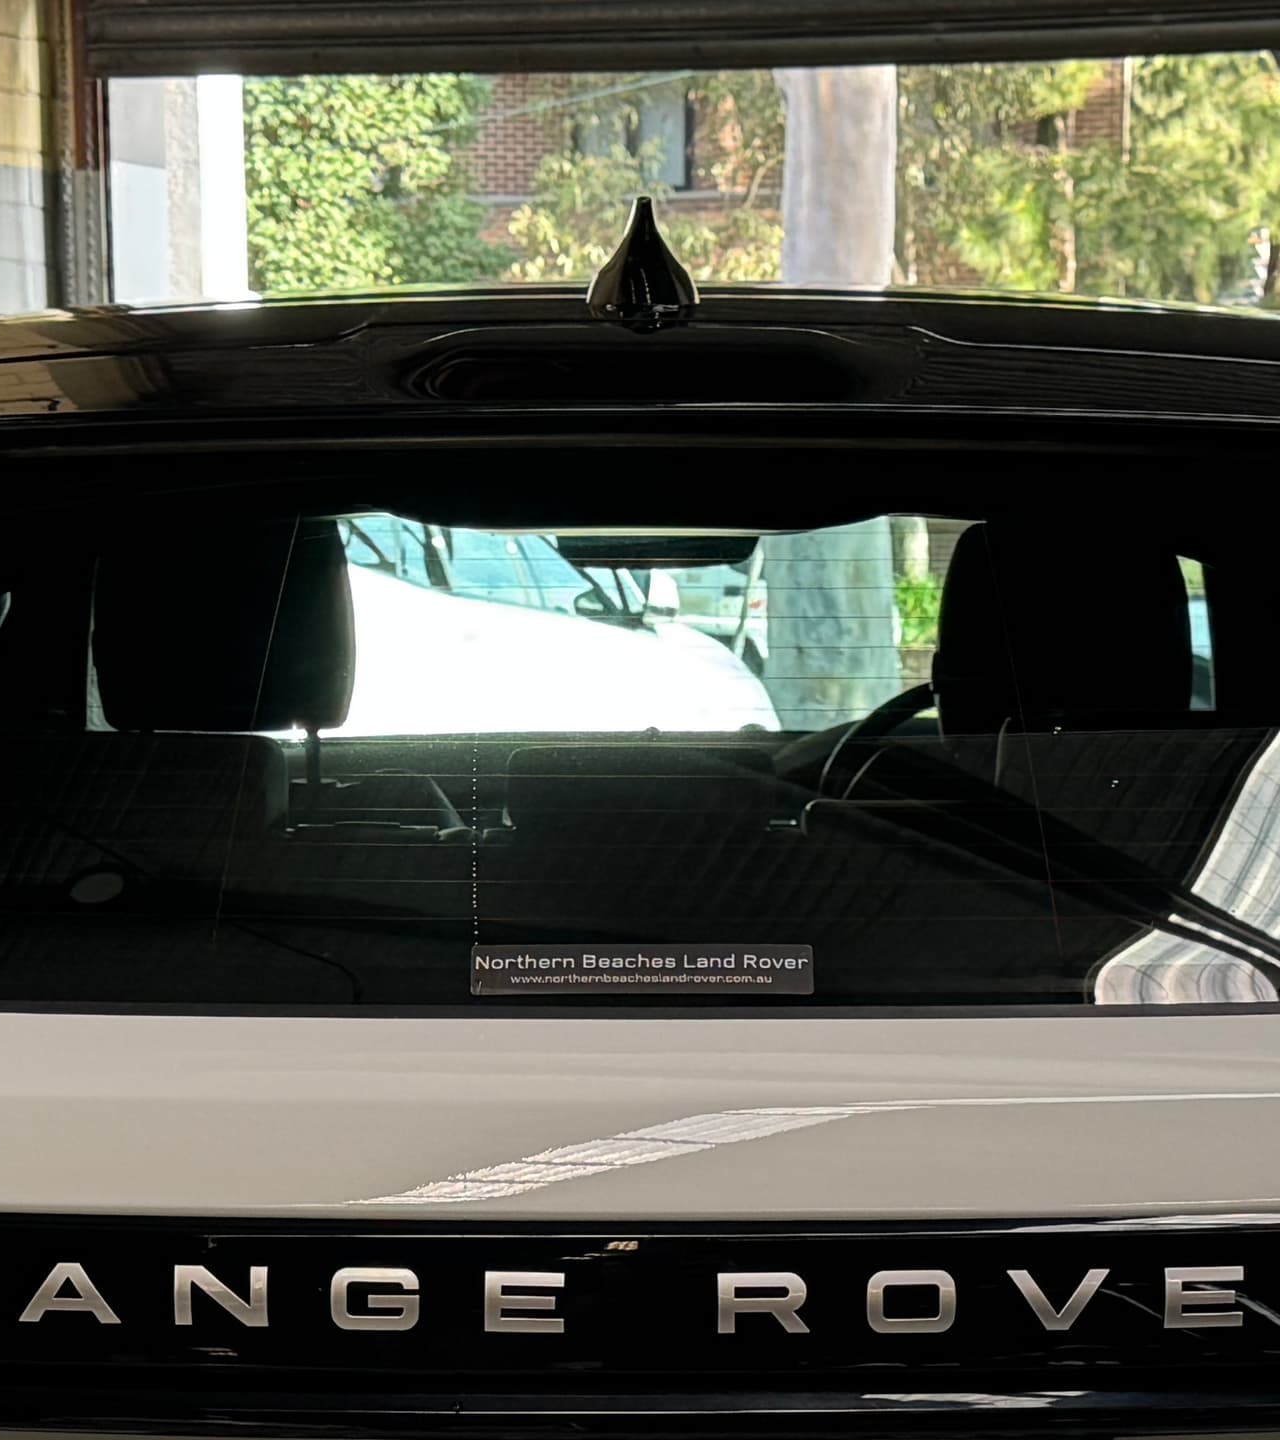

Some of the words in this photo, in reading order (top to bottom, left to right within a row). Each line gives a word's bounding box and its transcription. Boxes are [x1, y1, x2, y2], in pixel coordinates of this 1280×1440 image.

[475, 954, 575, 970] Northern
[582, 954, 676, 969] Beaches
[684, 954, 735, 969] Land
[743, 954, 808, 970] Rover
